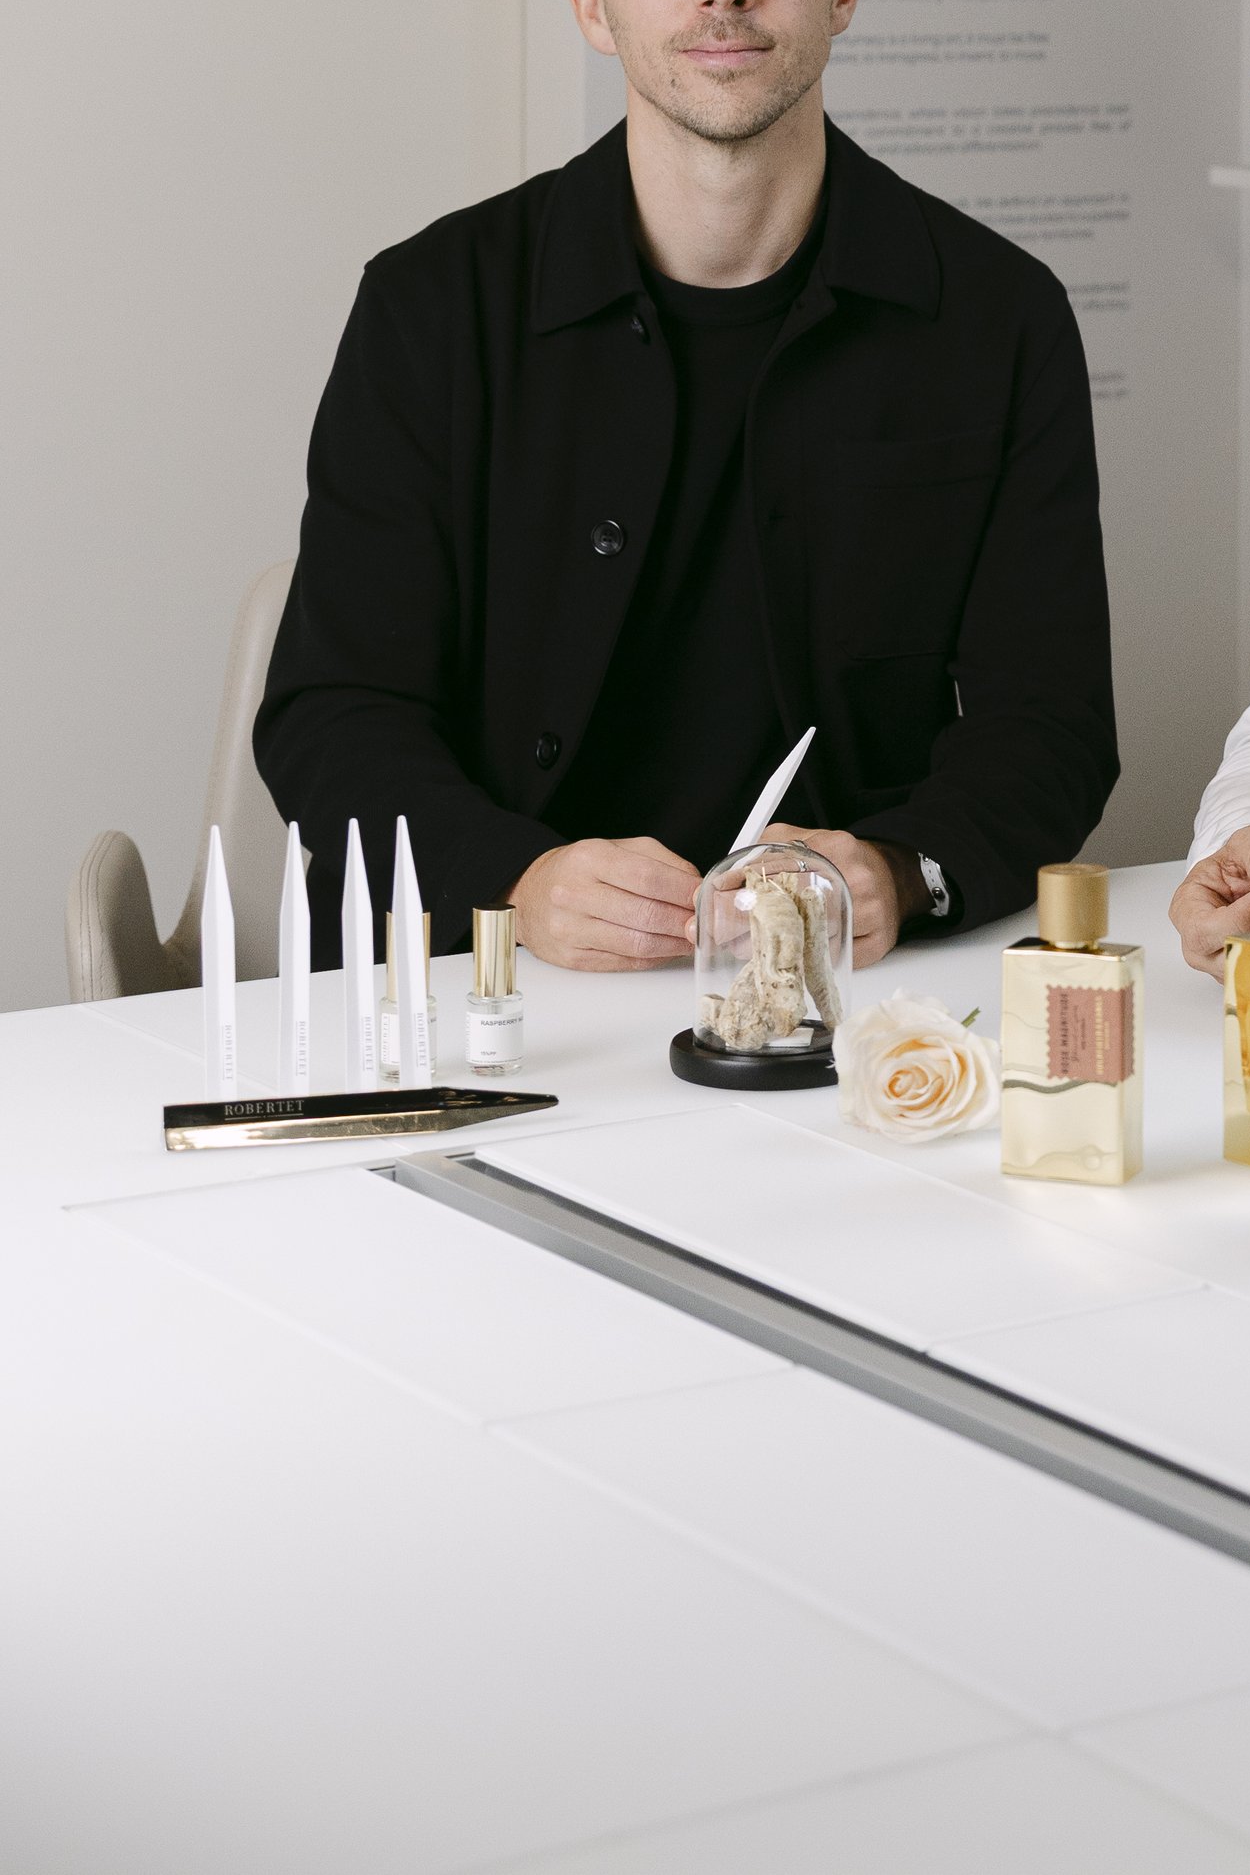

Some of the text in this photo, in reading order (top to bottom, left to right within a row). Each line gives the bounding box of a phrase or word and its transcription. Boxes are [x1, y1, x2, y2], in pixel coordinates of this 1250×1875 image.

[365, 1016, 373, 1070] ROBERTET
[417, 1012, 427, 1067] ROBERTET
[481, 1018, 517, 1026] RASPBERRY
[225, 1024, 233, 1079] ROBERTET
[224, 1100, 304, 1116] ROBERTET
